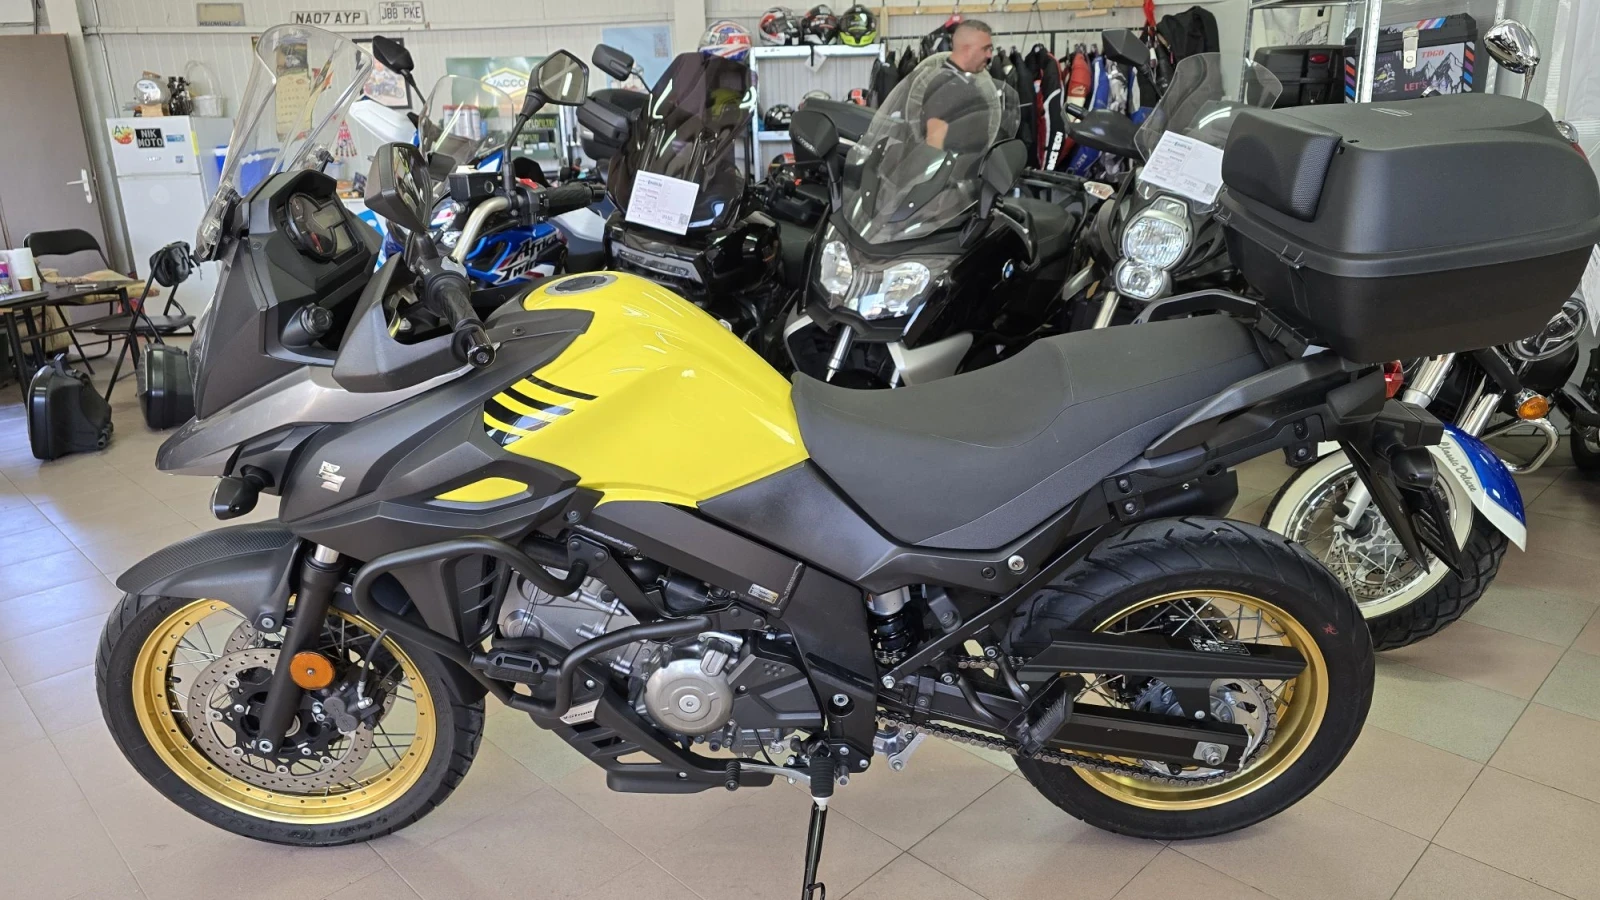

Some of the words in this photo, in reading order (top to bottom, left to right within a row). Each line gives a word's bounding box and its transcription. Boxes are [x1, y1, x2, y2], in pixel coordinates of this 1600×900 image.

[335, 12, 361, 23] AYP
[403, 6, 421, 19] PKE
[140, 129, 157, 139] NIK
[138, 138, 163, 148] MOTO
[1455, 464, 1478, 494] Deluxe
